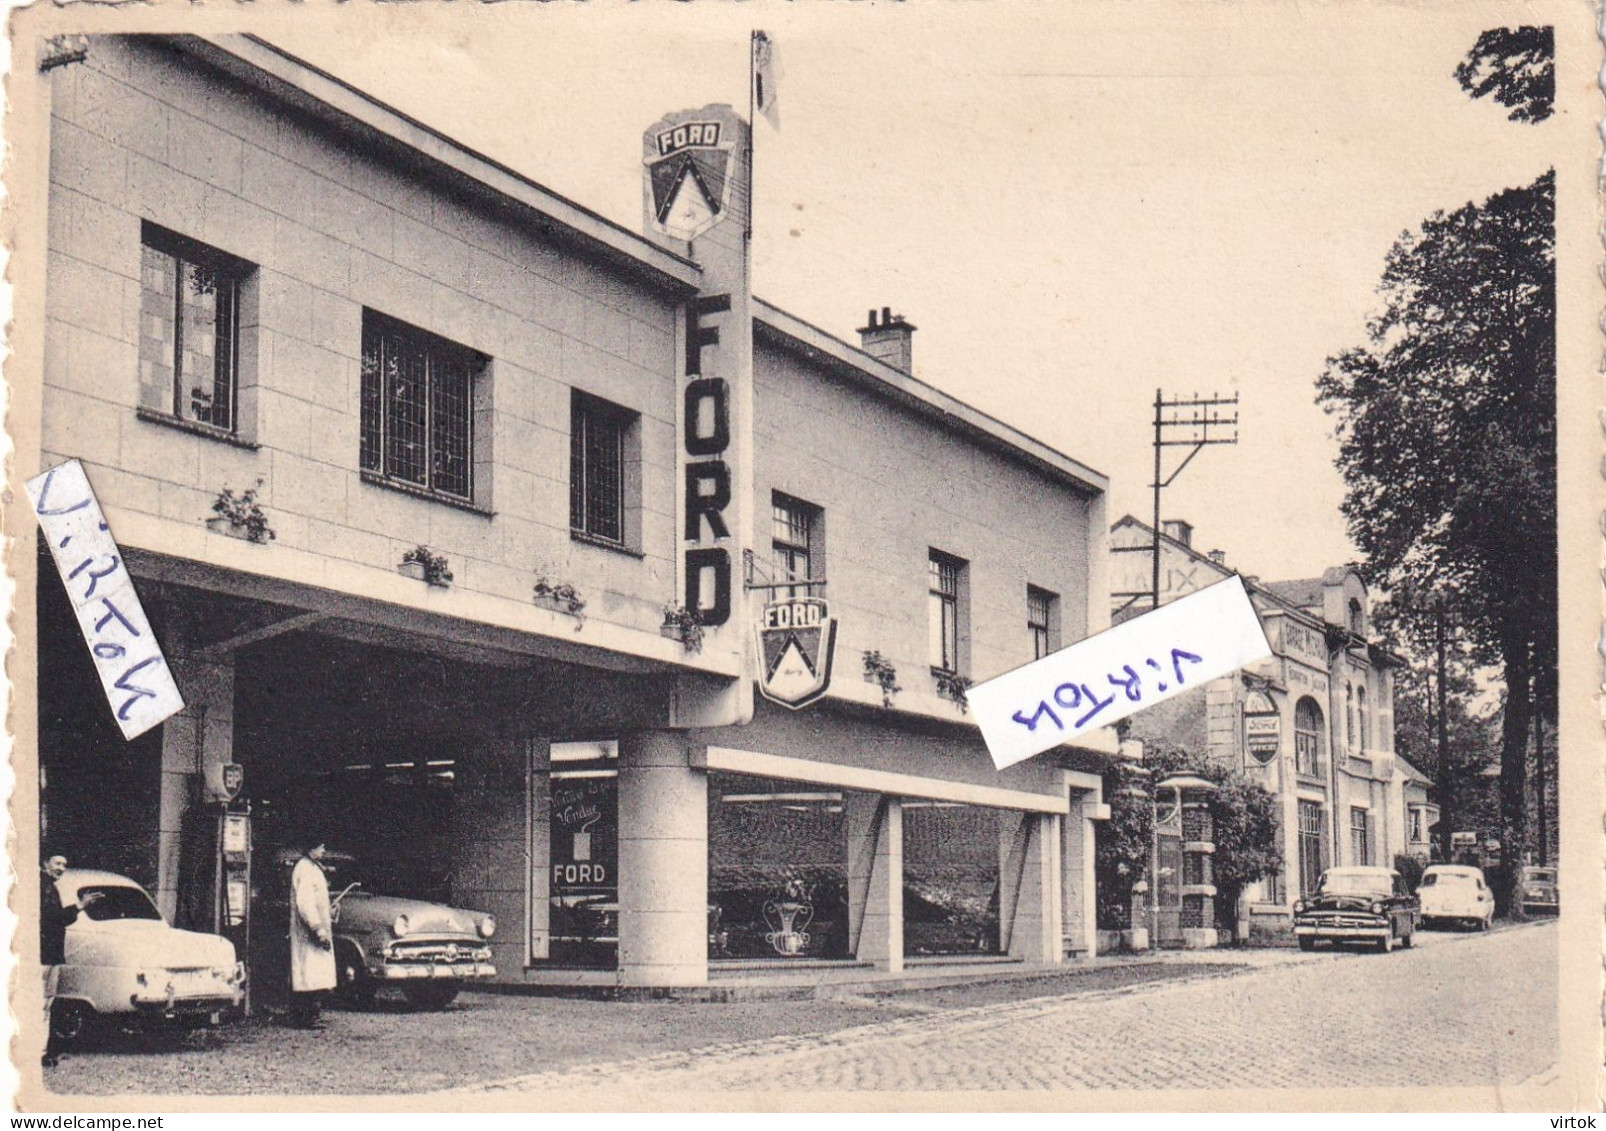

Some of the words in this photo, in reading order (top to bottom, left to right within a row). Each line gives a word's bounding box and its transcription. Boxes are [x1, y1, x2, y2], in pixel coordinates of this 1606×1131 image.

[660, 124, 717, 153] FORD
[684, 293, 732, 628] FORD
[764, 603, 820, 628] FORD
[226, 770, 241, 789] BP
[553, 864, 606, 884] FORD
